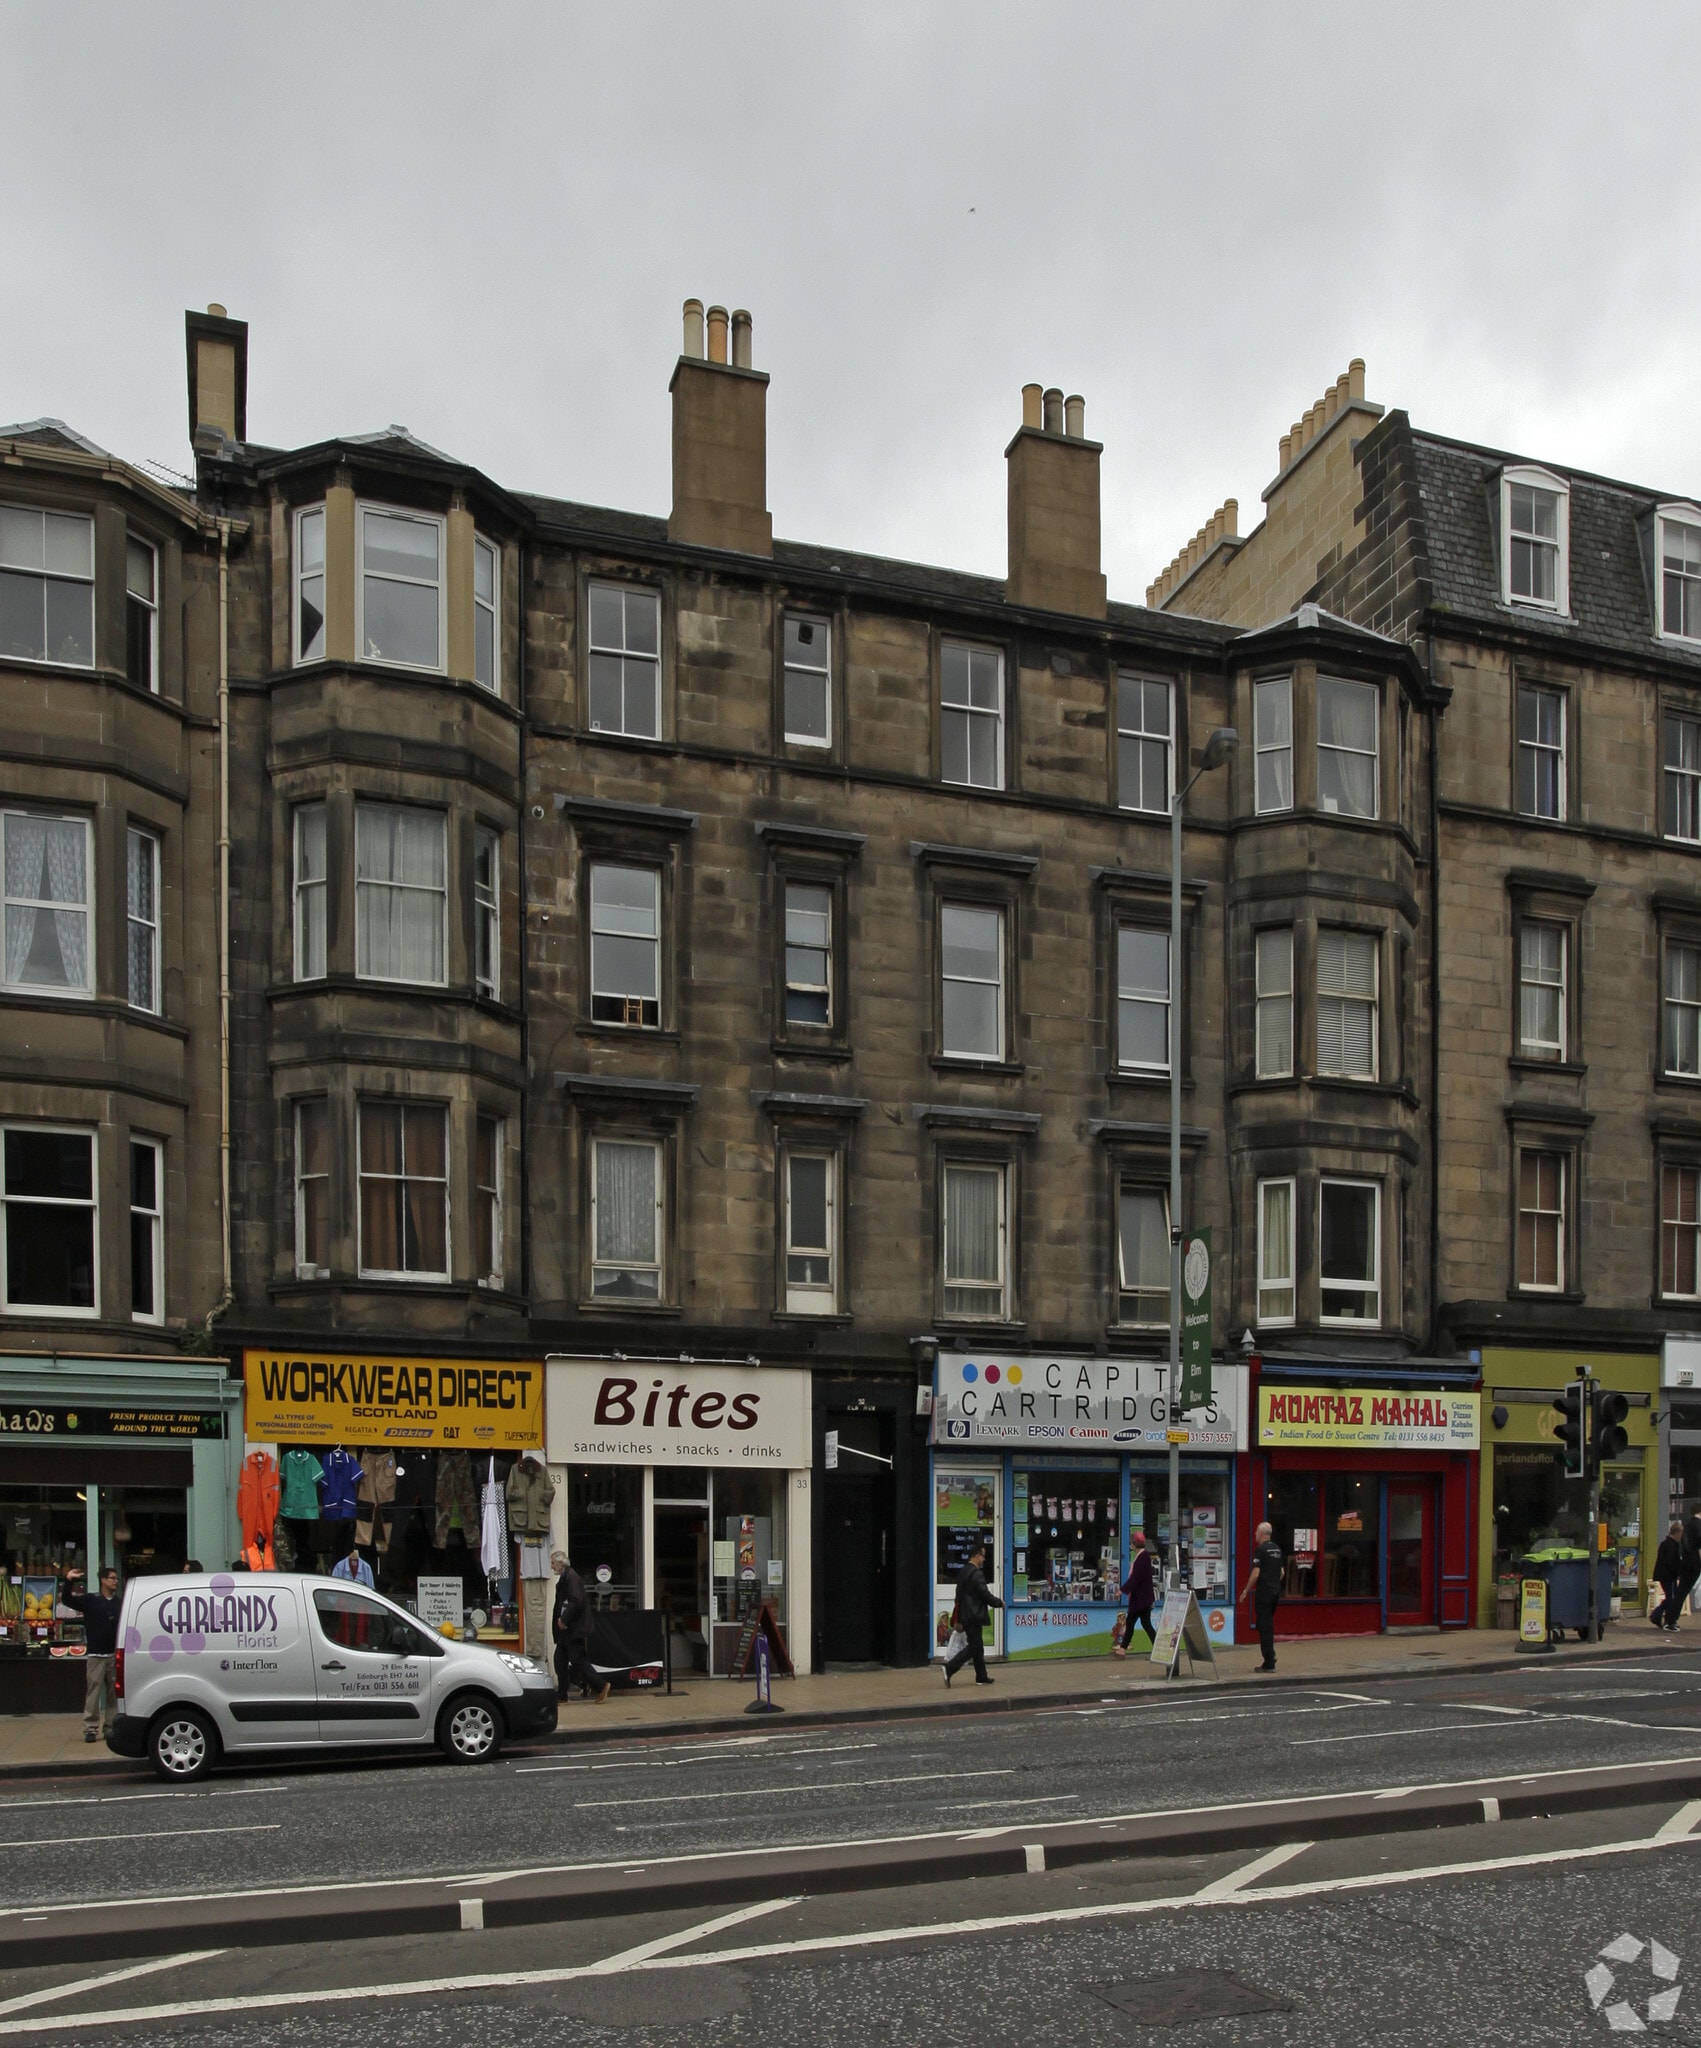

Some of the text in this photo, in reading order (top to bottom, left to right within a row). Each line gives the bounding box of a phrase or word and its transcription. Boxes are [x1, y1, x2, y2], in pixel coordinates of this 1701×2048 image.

[1185, 1312, 1209, 1328] Welcome
[1192, 1340, 1200, 1350] to
[1191, 1364, 1202, 1377] Elm
[260, 1361, 532, 1409] WORKWEAR DIRECT
[1190, 1390, 1203, 1402] Row
[594, 1378, 761, 1430] Bites
[1451, 1401, 1474, 1410] Curries
[352, 1407, 438, 1420] SCOTLAND
[1269, 1394, 1448, 1427] MUMTAZ MAHAL
[1453, 1411, 1472, 1419] Pizzas
[109, 1412, 136, 1421] FRESH
[138, 1413, 175, 1422] PRODUCE
[113, 1424, 148, 1432] AROUND
[170, 1426, 198, 1434] WORLD
[1451, 1420, 1474, 1428] Kebabs
[388, 1428, 431, 1438] Dickies
[443, 1427, 460, 1438] CAT
[975, 1424, 1021, 1437] LEXMARK
[1028, 1426, 1065, 1437] EPSON
[1069, 1426, 1109, 1438] Canon
[1201, 1433, 1214, 1442] 557
[1215, 1434, 1233, 1443] 3557
[1279, 1429, 1445, 1442] Indian Food & Sweet Centre Tel: 0131 556 8435
[1450, 1429, 1474, 1438] Burgers
[573, 1441, 782, 1457] sandwiches snacks drinks
[550, 1474, 562, 1484] 33
[796, 1479, 808, 1489] 33
[158, 1595, 278, 1634] GARLANDS
[1015, 1612, 1089, 1626] CASH 4 CLOTHES
[237, 1633, 278, 1648] Florist
[233, 1659, 278, 1670] Interflora
[357, 1673, 389, 1681] Edinburgh
[341, 1682, 370, 1692] Tel/Fax
[373, 1682, 388, 1690] 0131
[391, 1682, 405, 1690] 556
